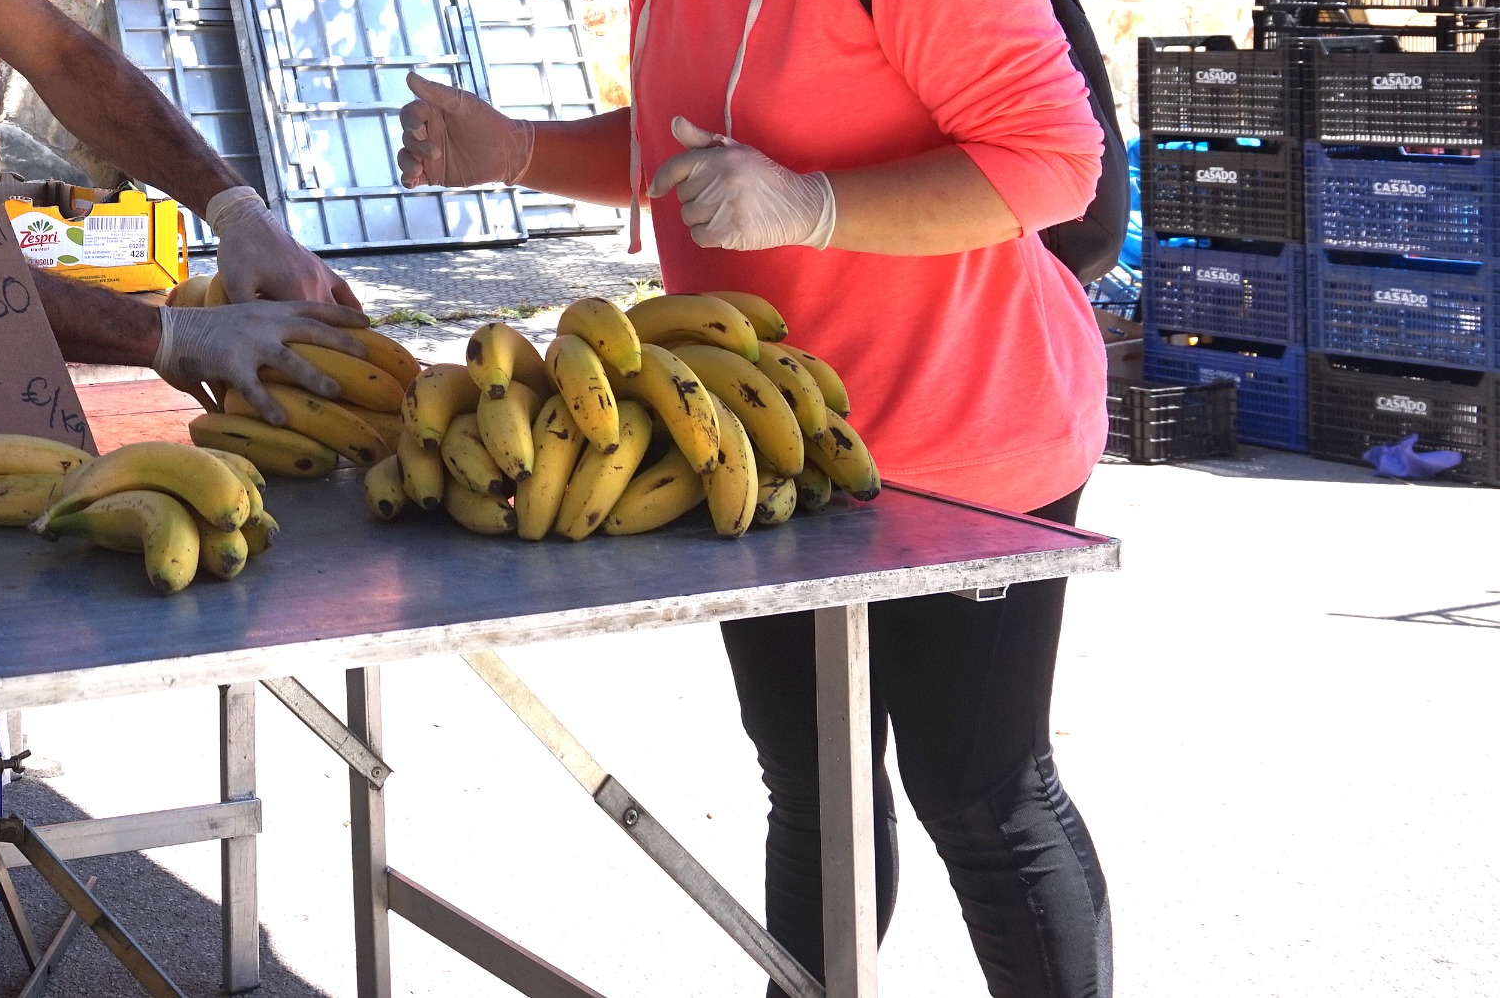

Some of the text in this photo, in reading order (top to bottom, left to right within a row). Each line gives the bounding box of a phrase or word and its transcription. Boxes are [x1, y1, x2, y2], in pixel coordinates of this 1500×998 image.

[1195, 71, 1237, 82] CASADO
[1372, 76, 1423, 87] CASADO
[1196, 169, 1238, 180] CASADO
[1373, 182, 1427, 194] CASADO
[19, 230, 59, 248] Zespri
[130, 250, 145, 258] 428
[1197, 269, 1240, 282] CASADO
[1374, 290, 1429, 304] CASADO
[1377, 396, 1427, 413] CASADO
